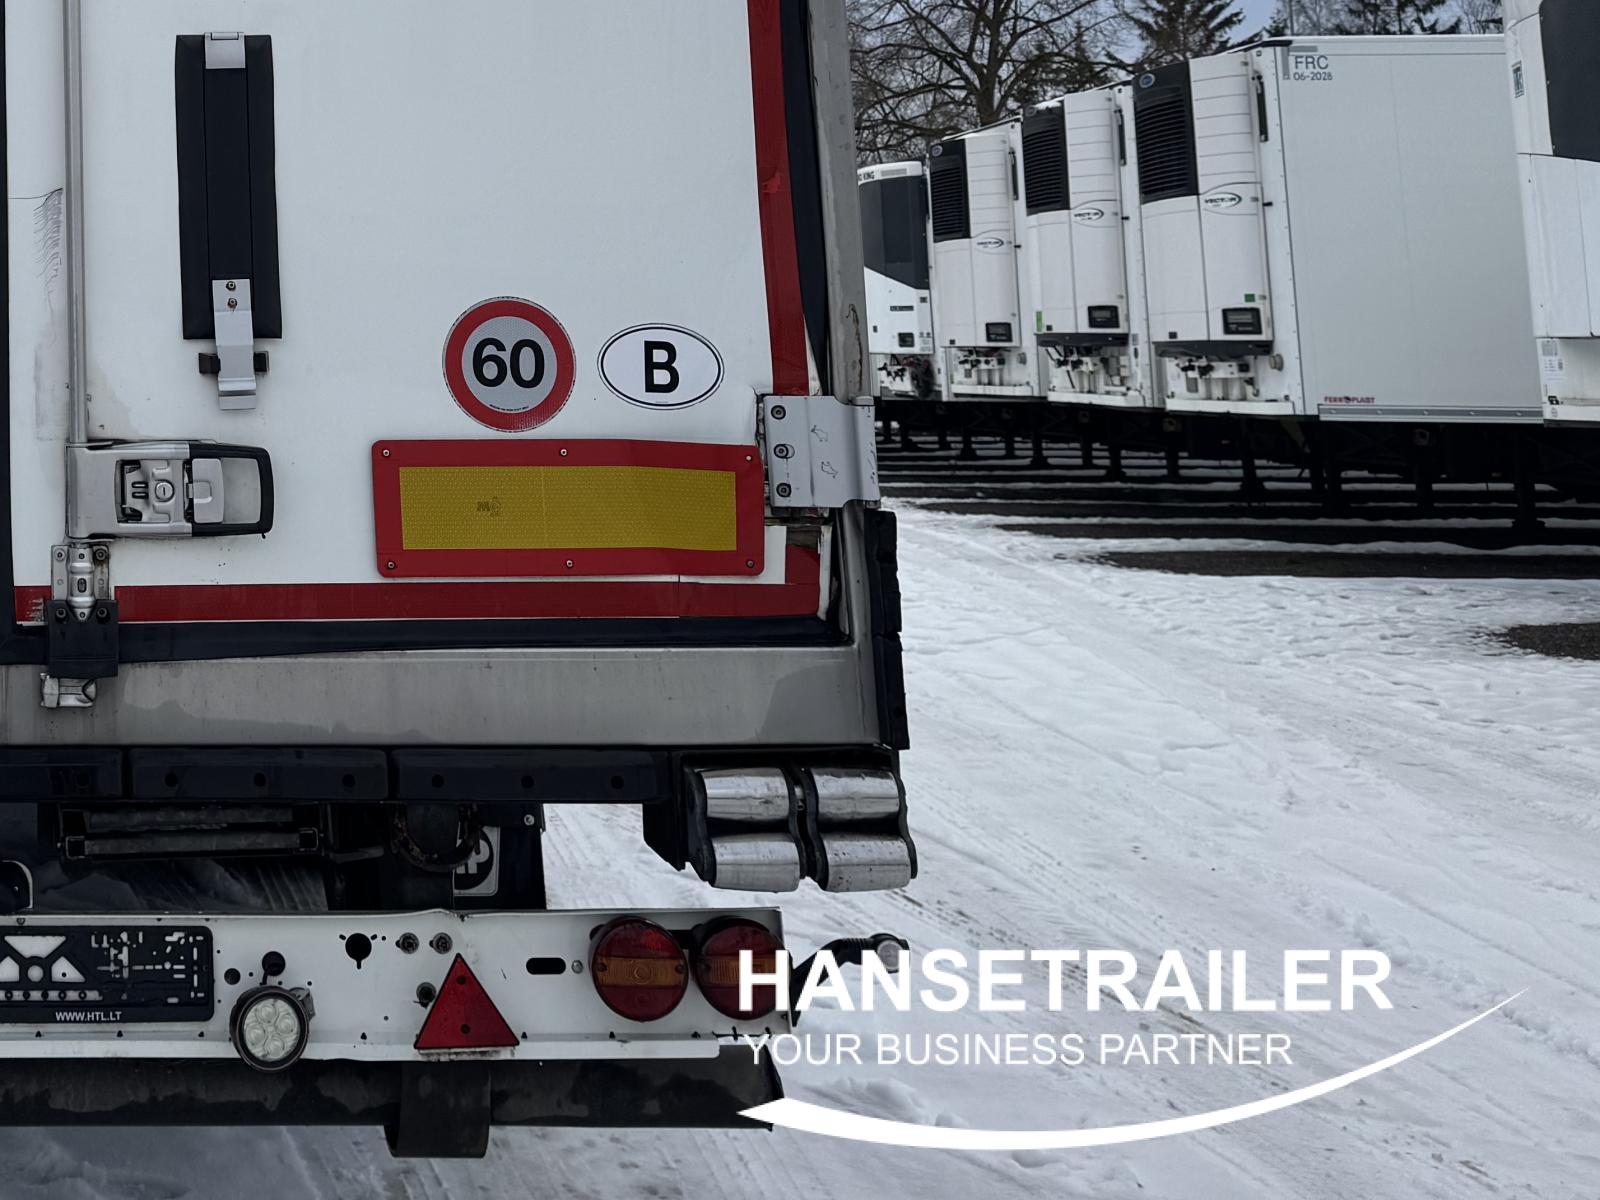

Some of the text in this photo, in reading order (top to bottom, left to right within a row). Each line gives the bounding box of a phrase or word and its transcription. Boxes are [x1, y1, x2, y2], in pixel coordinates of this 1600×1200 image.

[1294, 55, 1329, 70] FRC
[472, 337, 545, 389] 60
[643, 340, 680, 394] B
[55, 1011, 122, 1021] WWW.HTL.LT
